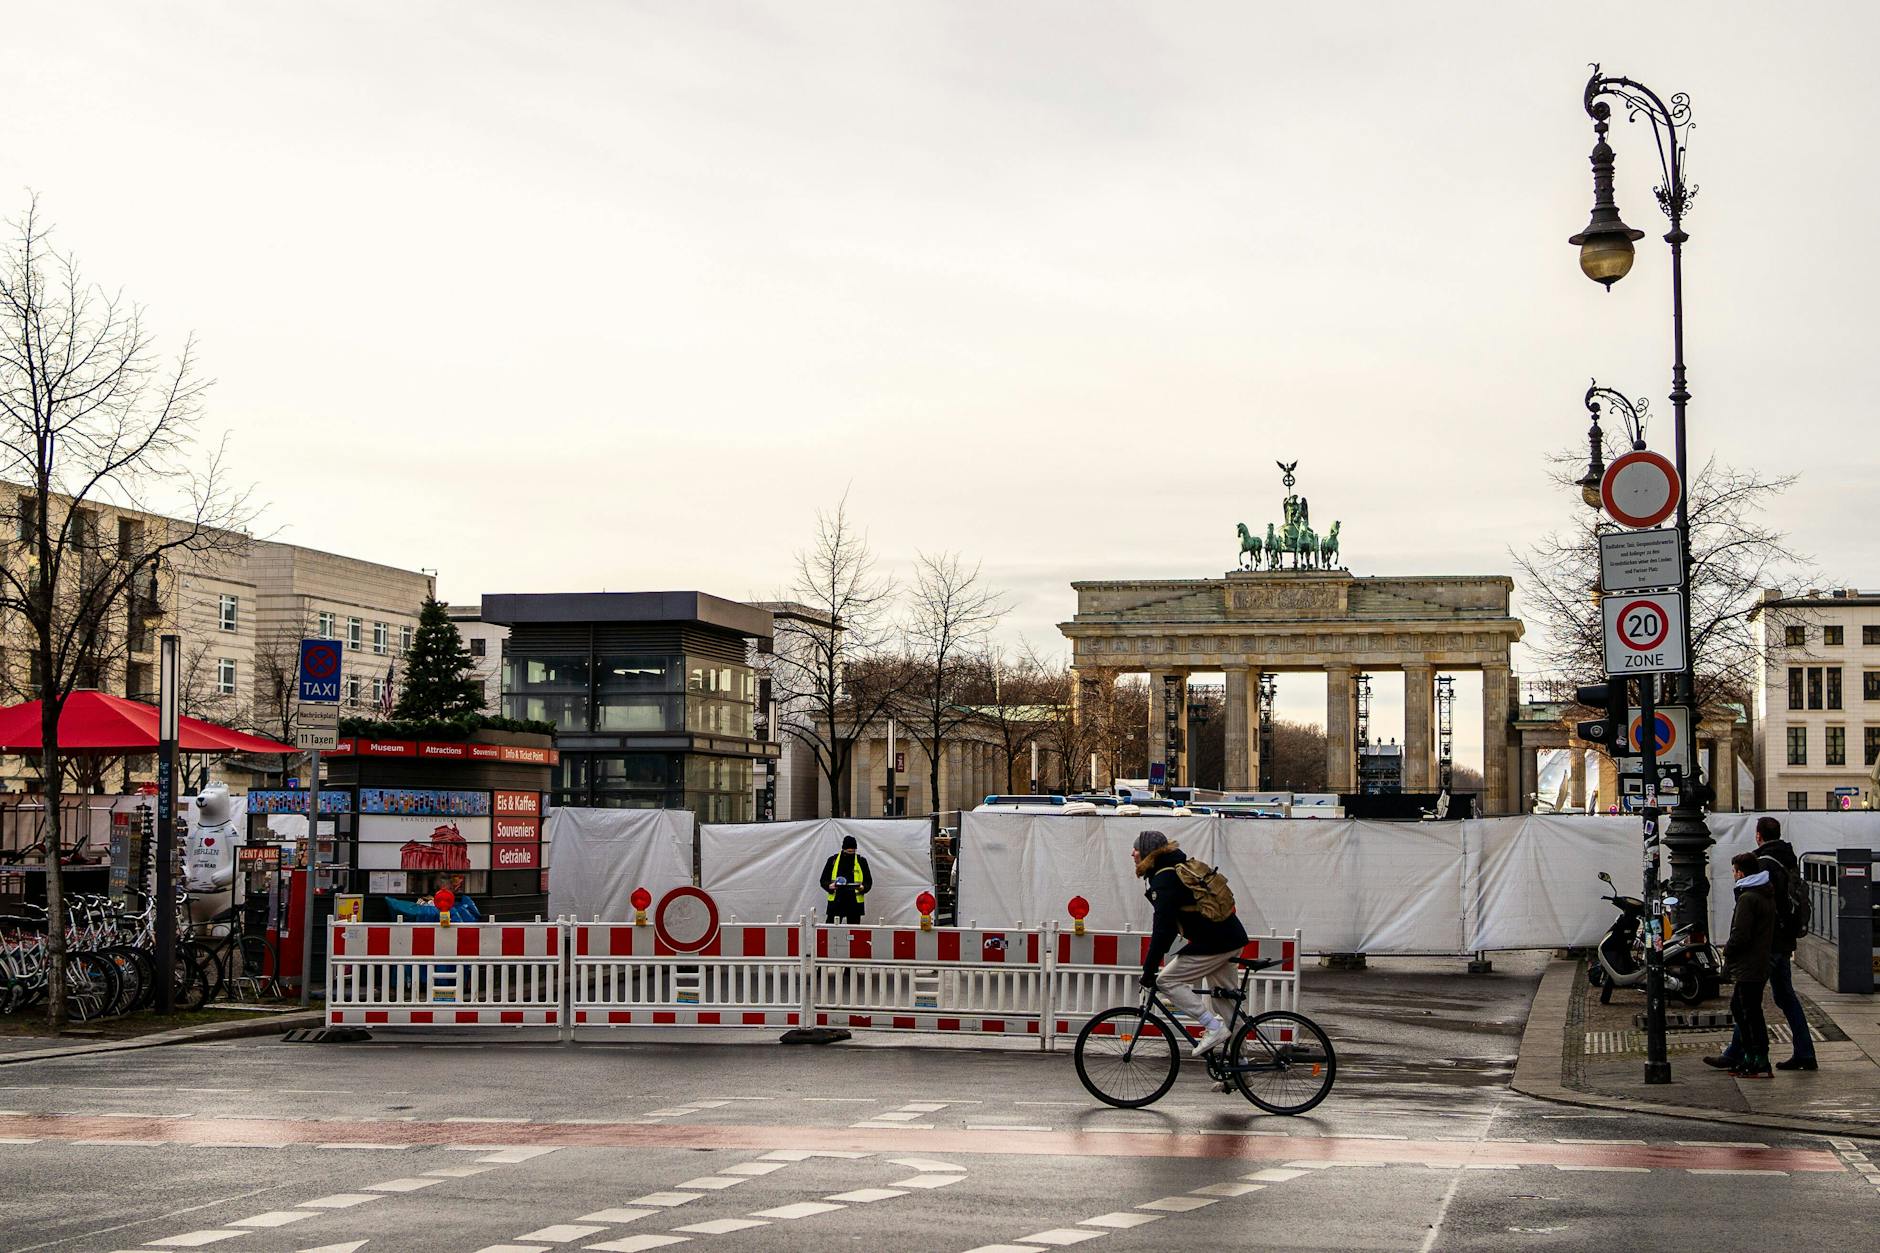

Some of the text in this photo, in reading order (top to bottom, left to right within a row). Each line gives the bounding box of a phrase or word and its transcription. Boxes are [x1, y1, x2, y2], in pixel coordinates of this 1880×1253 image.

[1628, 613, 1658, 638] 20
[1624, 653, 1665, 668] ZONE
[303, 682, 337, 697] TAXI
[300, 734, 334, 745] 11 Taxen
[370, 743, 404, 752] Museum
[425, 745, 462, 755] Attractions
[505, 749, 514, 759] Info
[519, 750, 533, 760] Ticket
[532, 752, 544, 761] Point
[497, 795, 536, 811] Eis & Kaffee
[497, 821, 535, 838] Souveniers
[198, 837, 203, 847] I
[193, 848, 220, 856] BERLIN
[240, 848, 279, 859] RENT A BIKE
[499, 847, 531, 864] Getränke
